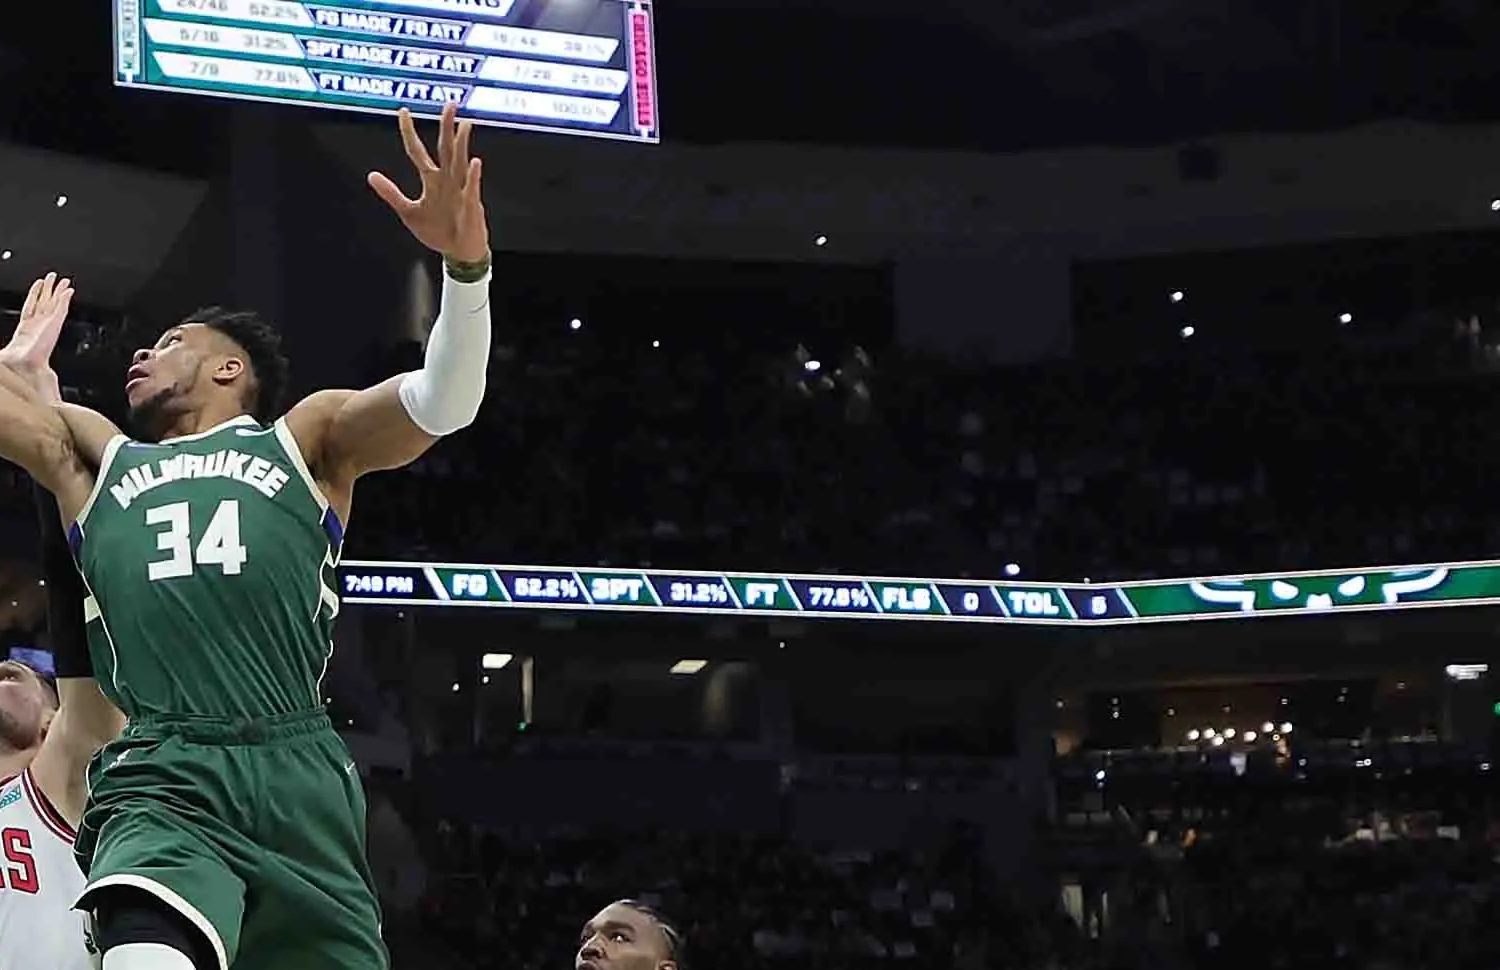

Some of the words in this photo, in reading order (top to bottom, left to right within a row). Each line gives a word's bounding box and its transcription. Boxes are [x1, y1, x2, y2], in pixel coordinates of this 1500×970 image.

[342, 13, 391, 32] MADE
[431, 23, 462, 40] ATT
[343, 45, 392, 64] MADE
[442, 56, 474, 73] ATT
[320, 74, 341, 89] FT
[344, 76, 393, 96] MADE
[408, 83, 429, 99] FT
[432, 87, 464, 104] ATT
[109, 450, 290, 510] MILWAUKEE
[146, 500, 247, 581] 34
[386, 576, 414, 594] PM
[670, 581, 728, 603] 31.2%
[745, 583, 780, 605] FT
[1009, 590, 1061, 615] TOL
